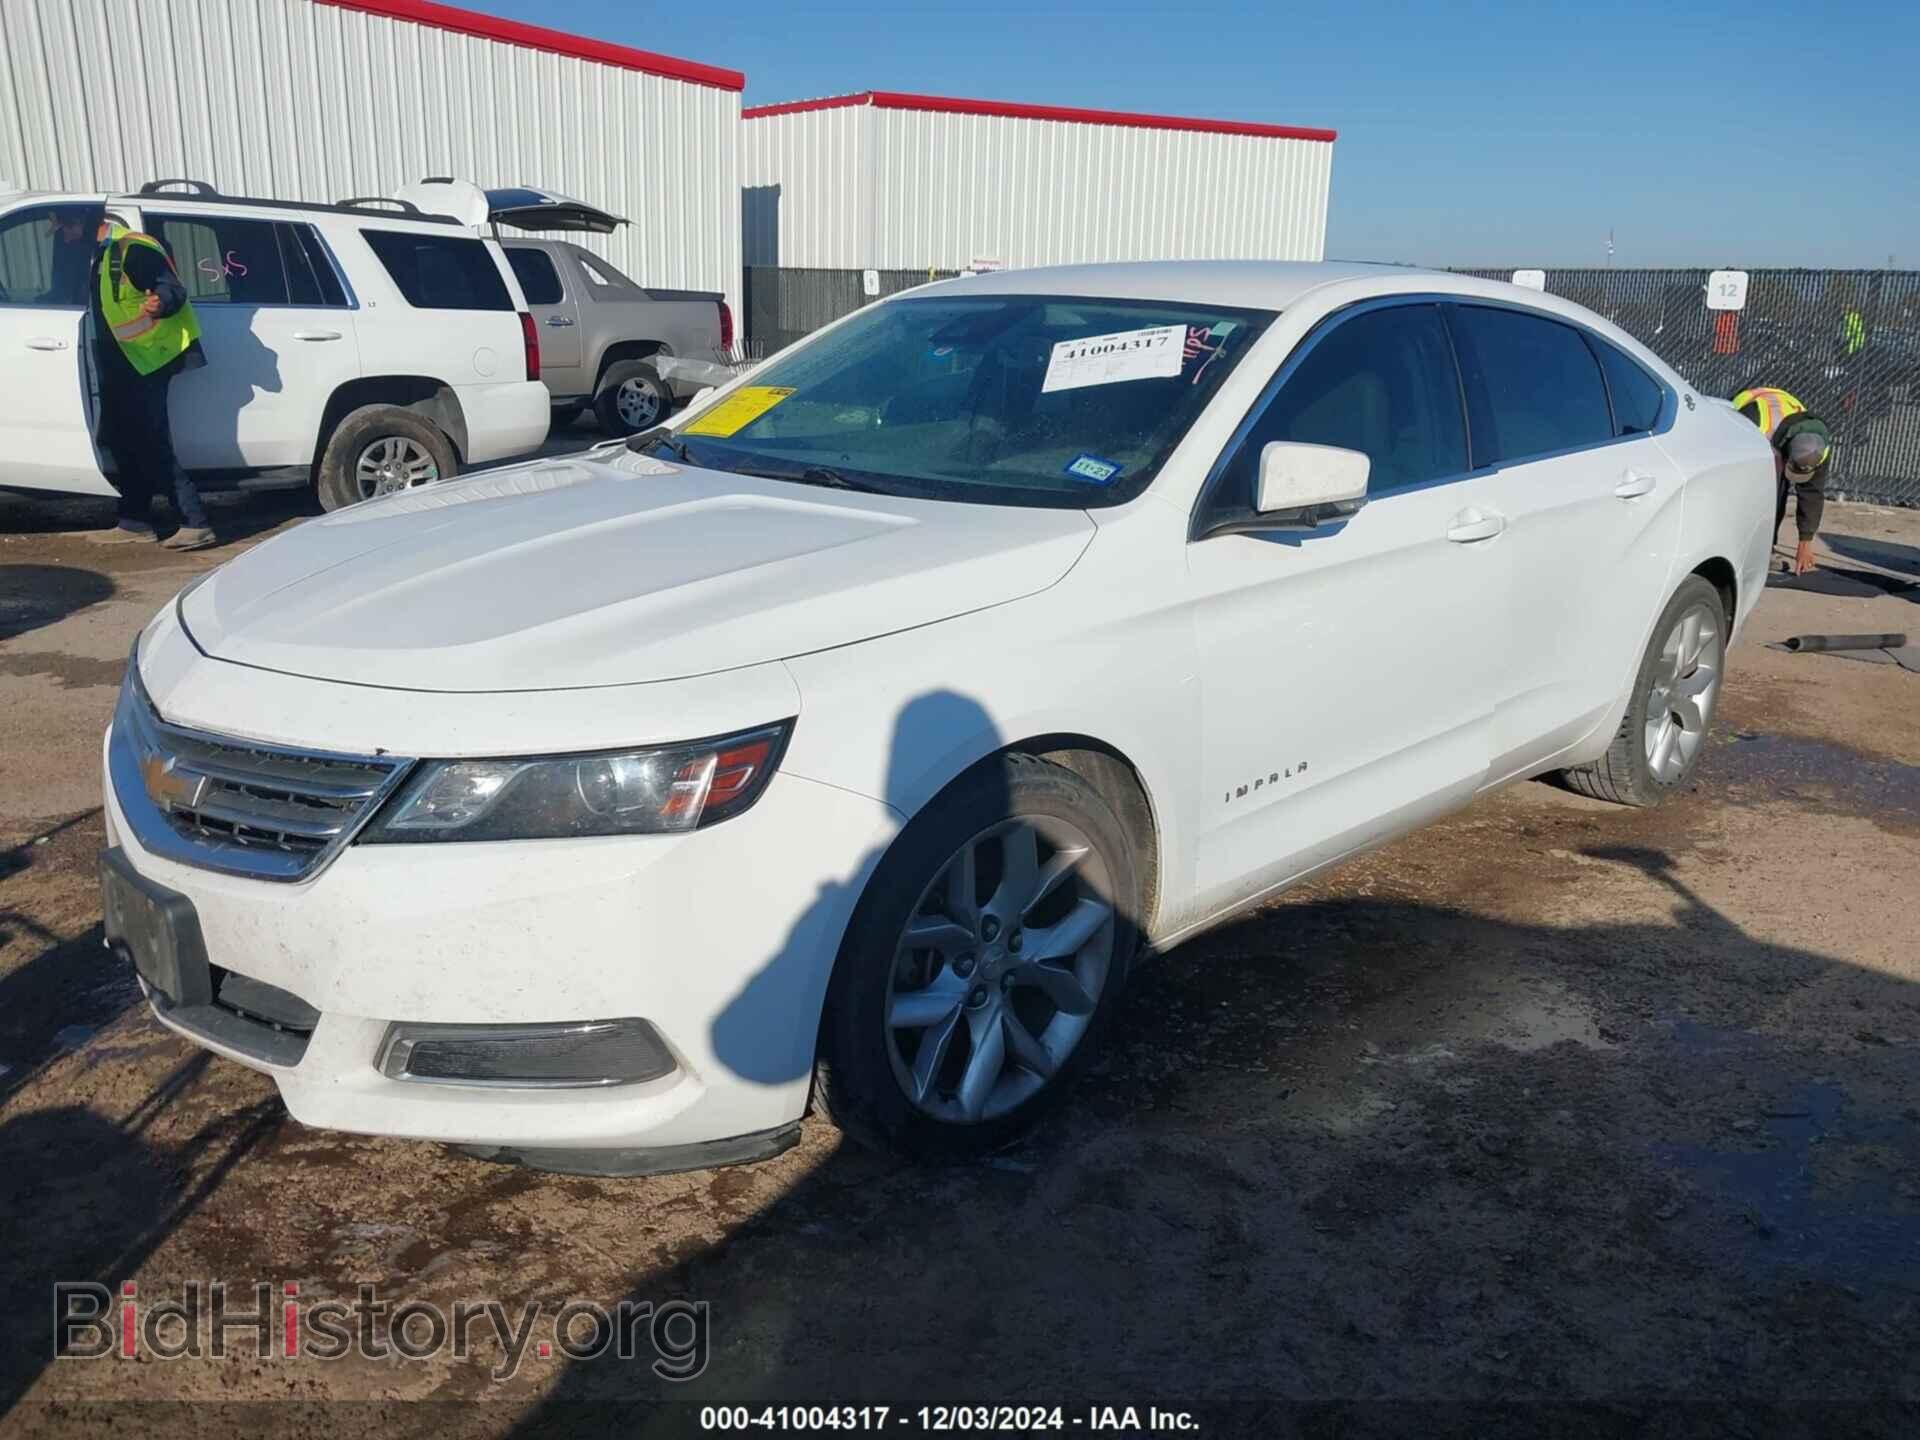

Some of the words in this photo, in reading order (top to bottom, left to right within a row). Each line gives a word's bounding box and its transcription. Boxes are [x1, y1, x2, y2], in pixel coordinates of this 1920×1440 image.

[1719, 283, 1737, 297] 12
[1063, 336, 1168, 359] 41004317
[1224, 761, 1308, 803] IMPALA
